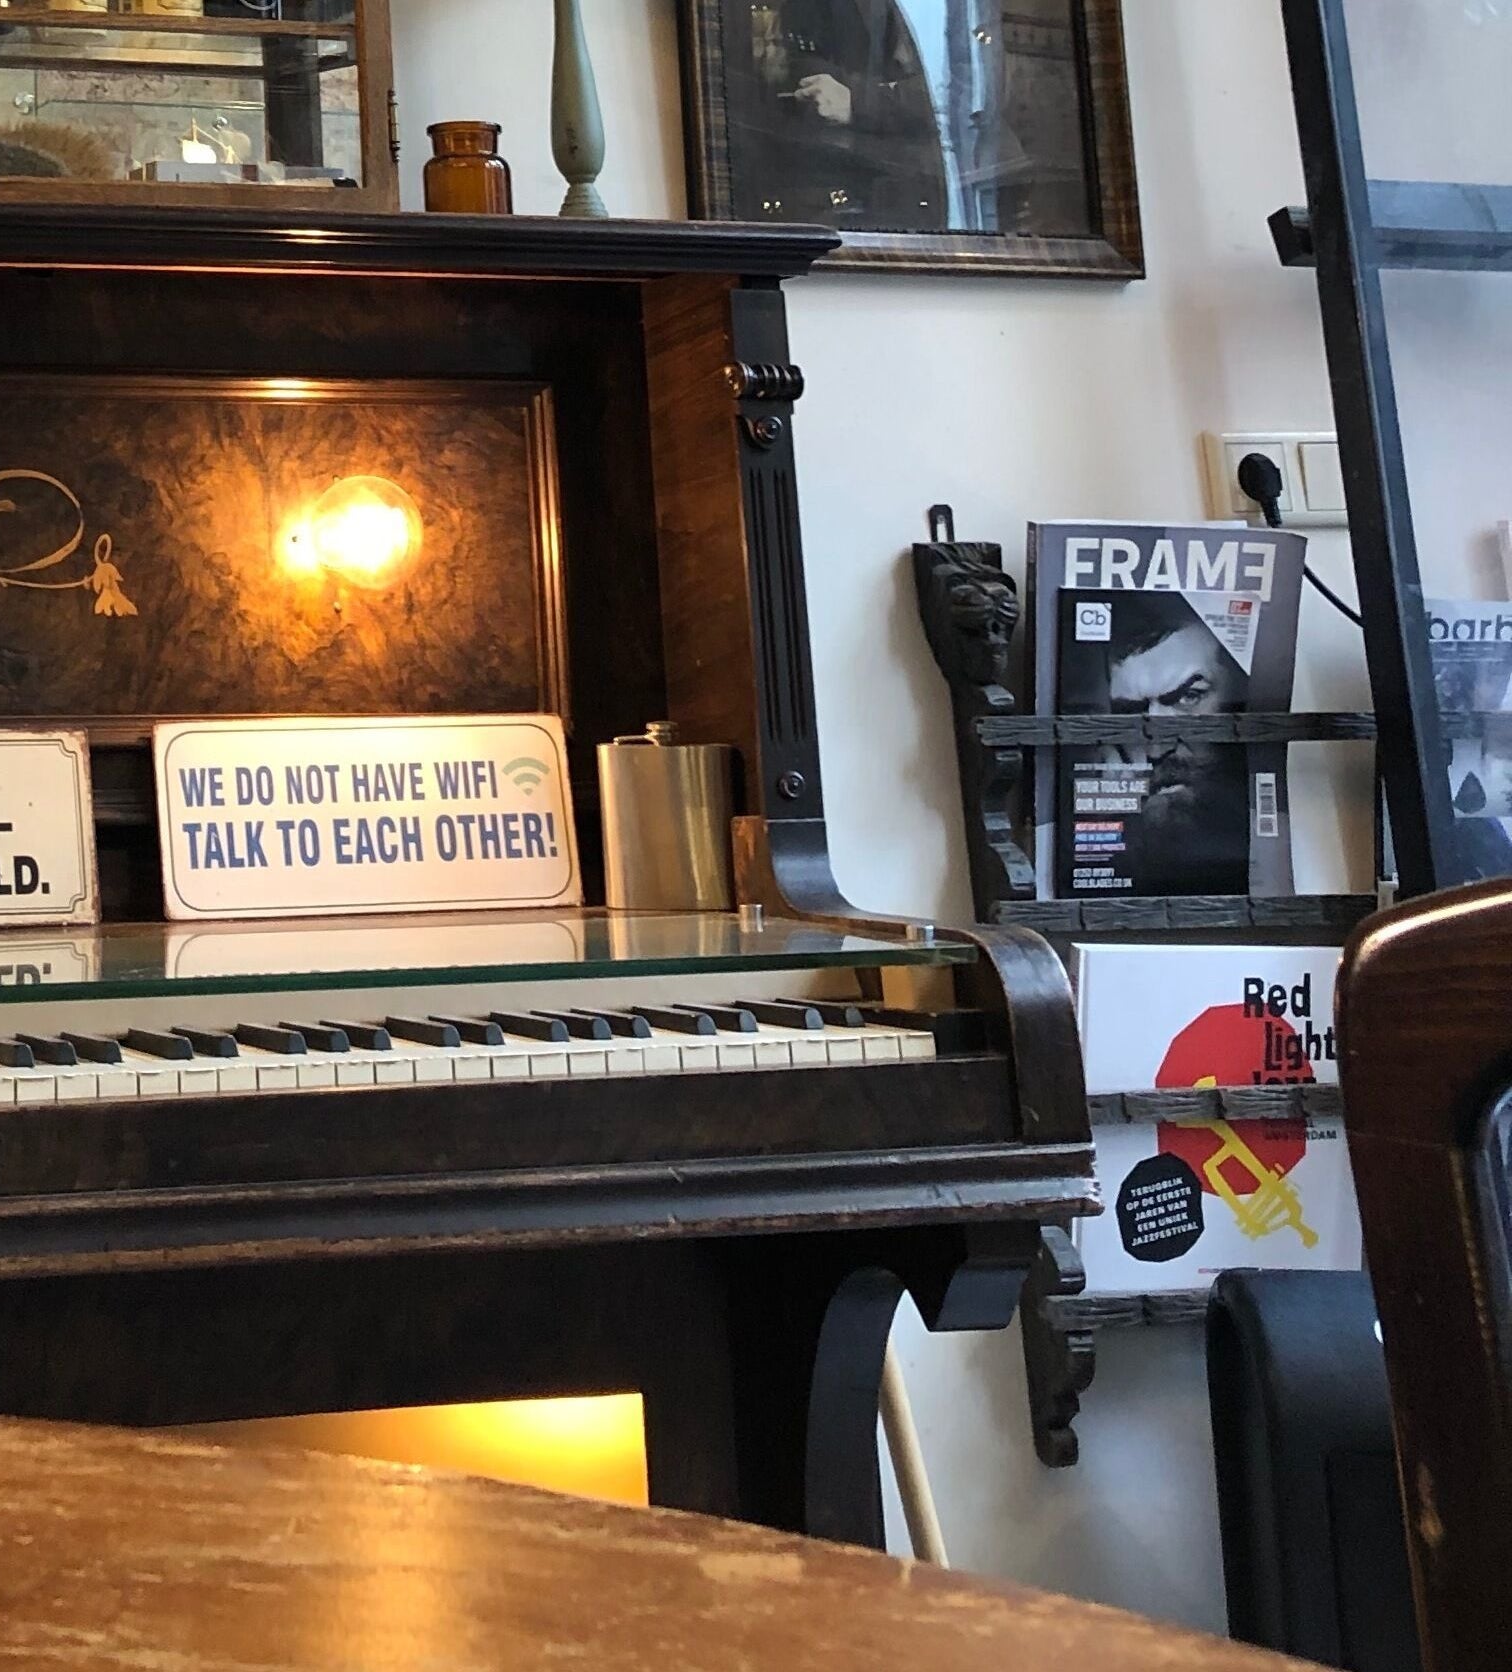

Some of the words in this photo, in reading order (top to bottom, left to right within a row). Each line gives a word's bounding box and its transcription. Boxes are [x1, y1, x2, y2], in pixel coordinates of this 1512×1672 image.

[1065, 538, 1276, 602] FRAME
[1080, 609, 1107, 626] Cb
[179, 767, 226, 807] WE
[234, 765, 275, 806] DO
[285, 764, 340, 805] NOT
[351, 762, 426, 803] HAVE
[433, 760, 499, 800] WIFI
[182, 821, 268, 870] TALK
[275, 818, 321, 867] TO
[332, 815, 424, 865] EACH
[434, 812, 559, 863] OTHER!
[1243, 973, 1311, 1018] Red
[1126, 1200, 1140, 1211] OP
[1141, 1196, 1155, 1207] DE
[1130, 1177, 1183, 1197] TERUGBLIK
